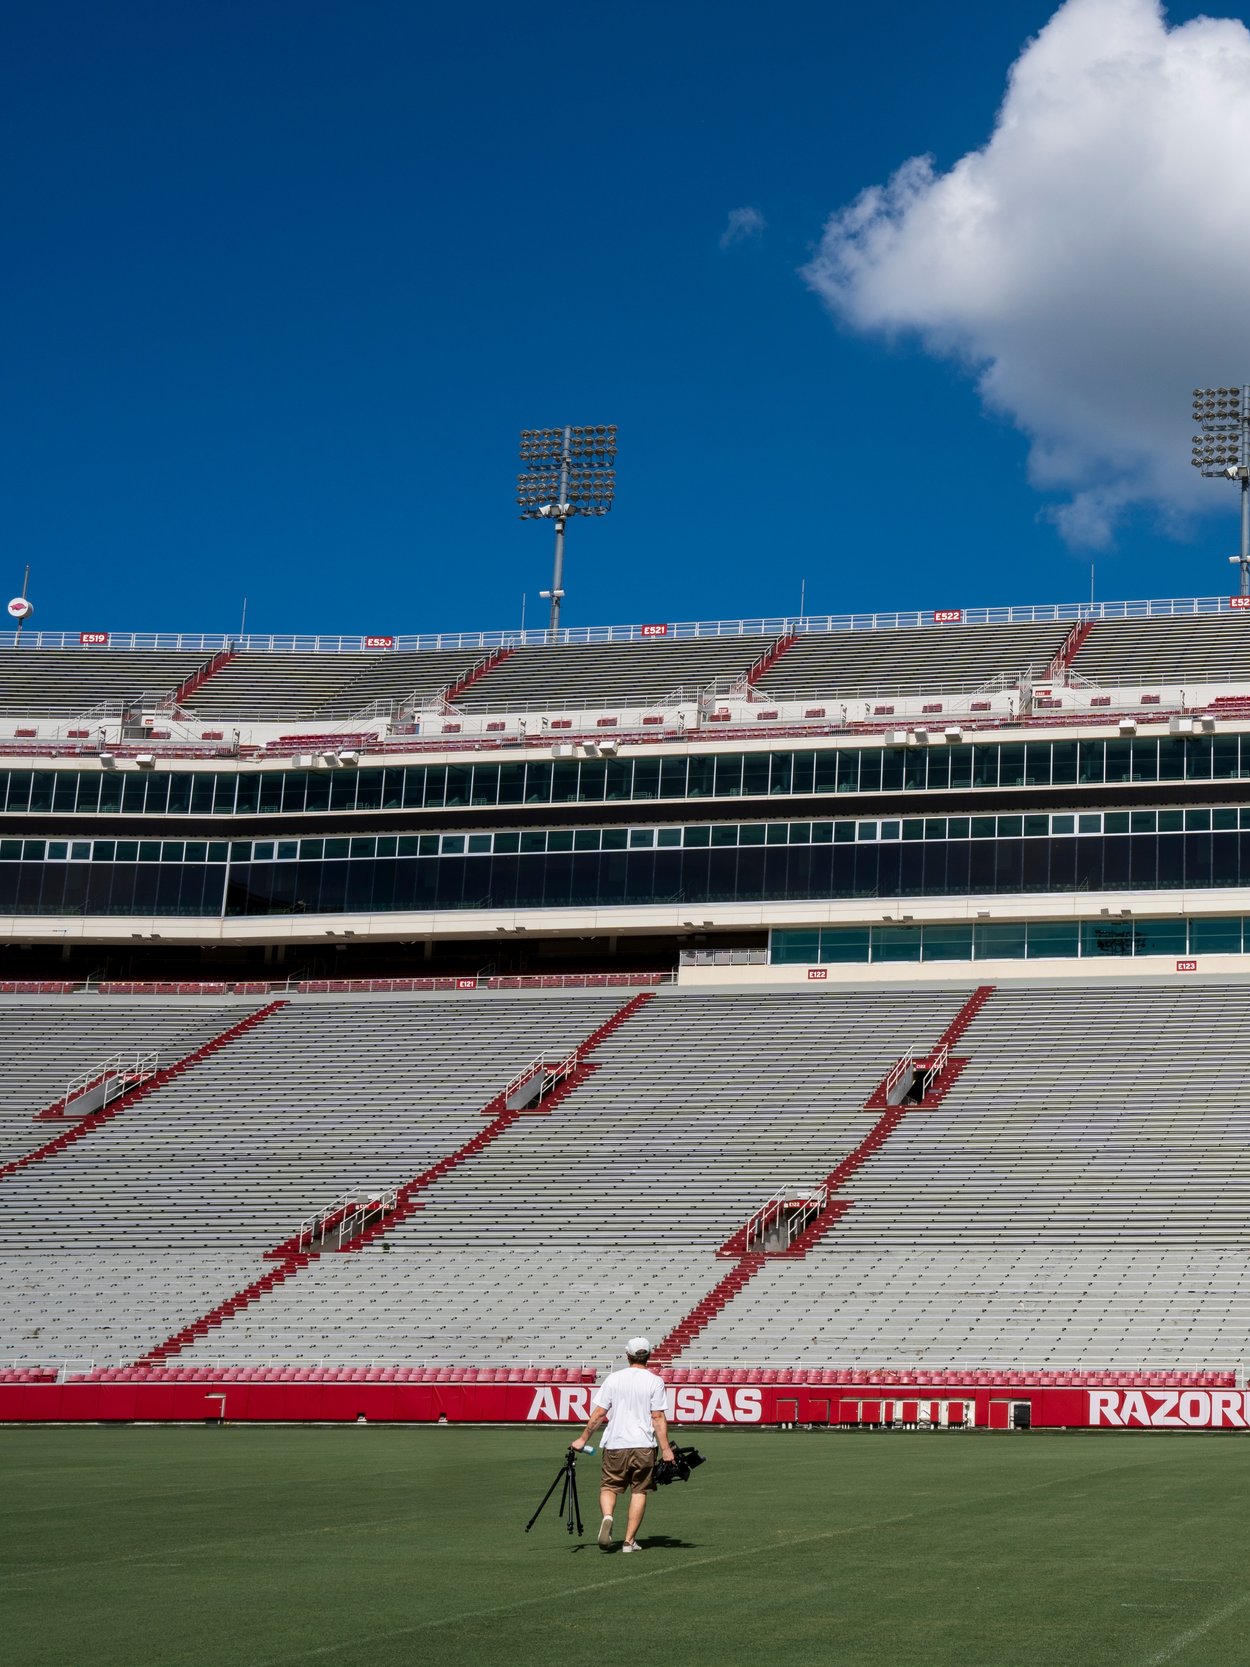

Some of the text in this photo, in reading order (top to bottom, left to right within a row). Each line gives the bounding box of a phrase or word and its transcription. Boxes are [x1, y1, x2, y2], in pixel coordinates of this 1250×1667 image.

[935, 612, 960, 621] E522
[644, 626, 665, 634] E521
[82, 634, 105, 642] E519
[526, 1387, 762, 1422] ARSAS
